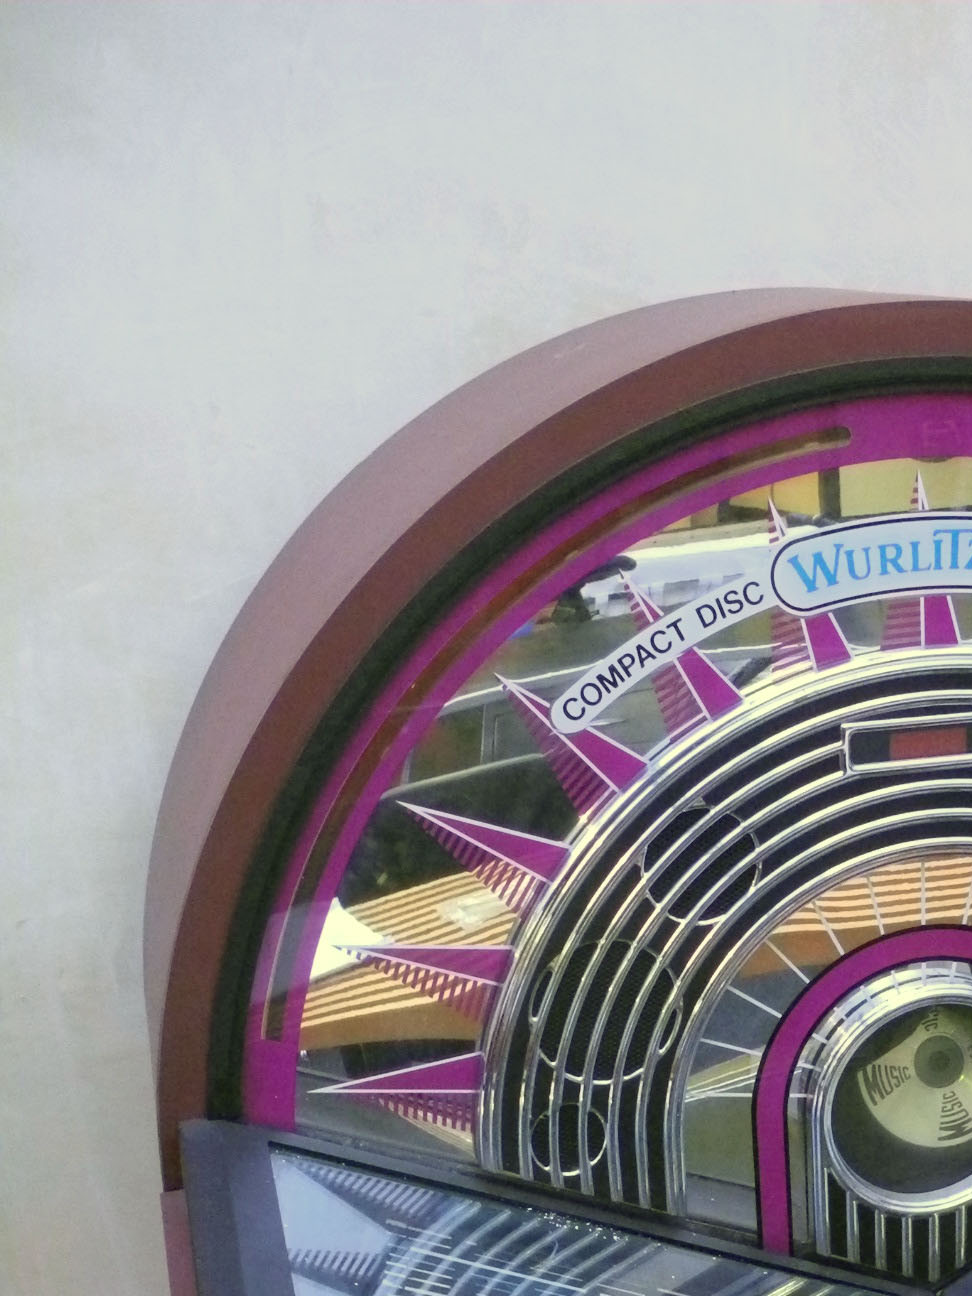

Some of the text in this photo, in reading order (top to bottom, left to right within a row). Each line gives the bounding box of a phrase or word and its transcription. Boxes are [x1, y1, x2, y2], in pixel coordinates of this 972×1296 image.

[560, 581, 766, 723] COMPACT DISC
[862, 1063, 912, 1107] MUSIC
